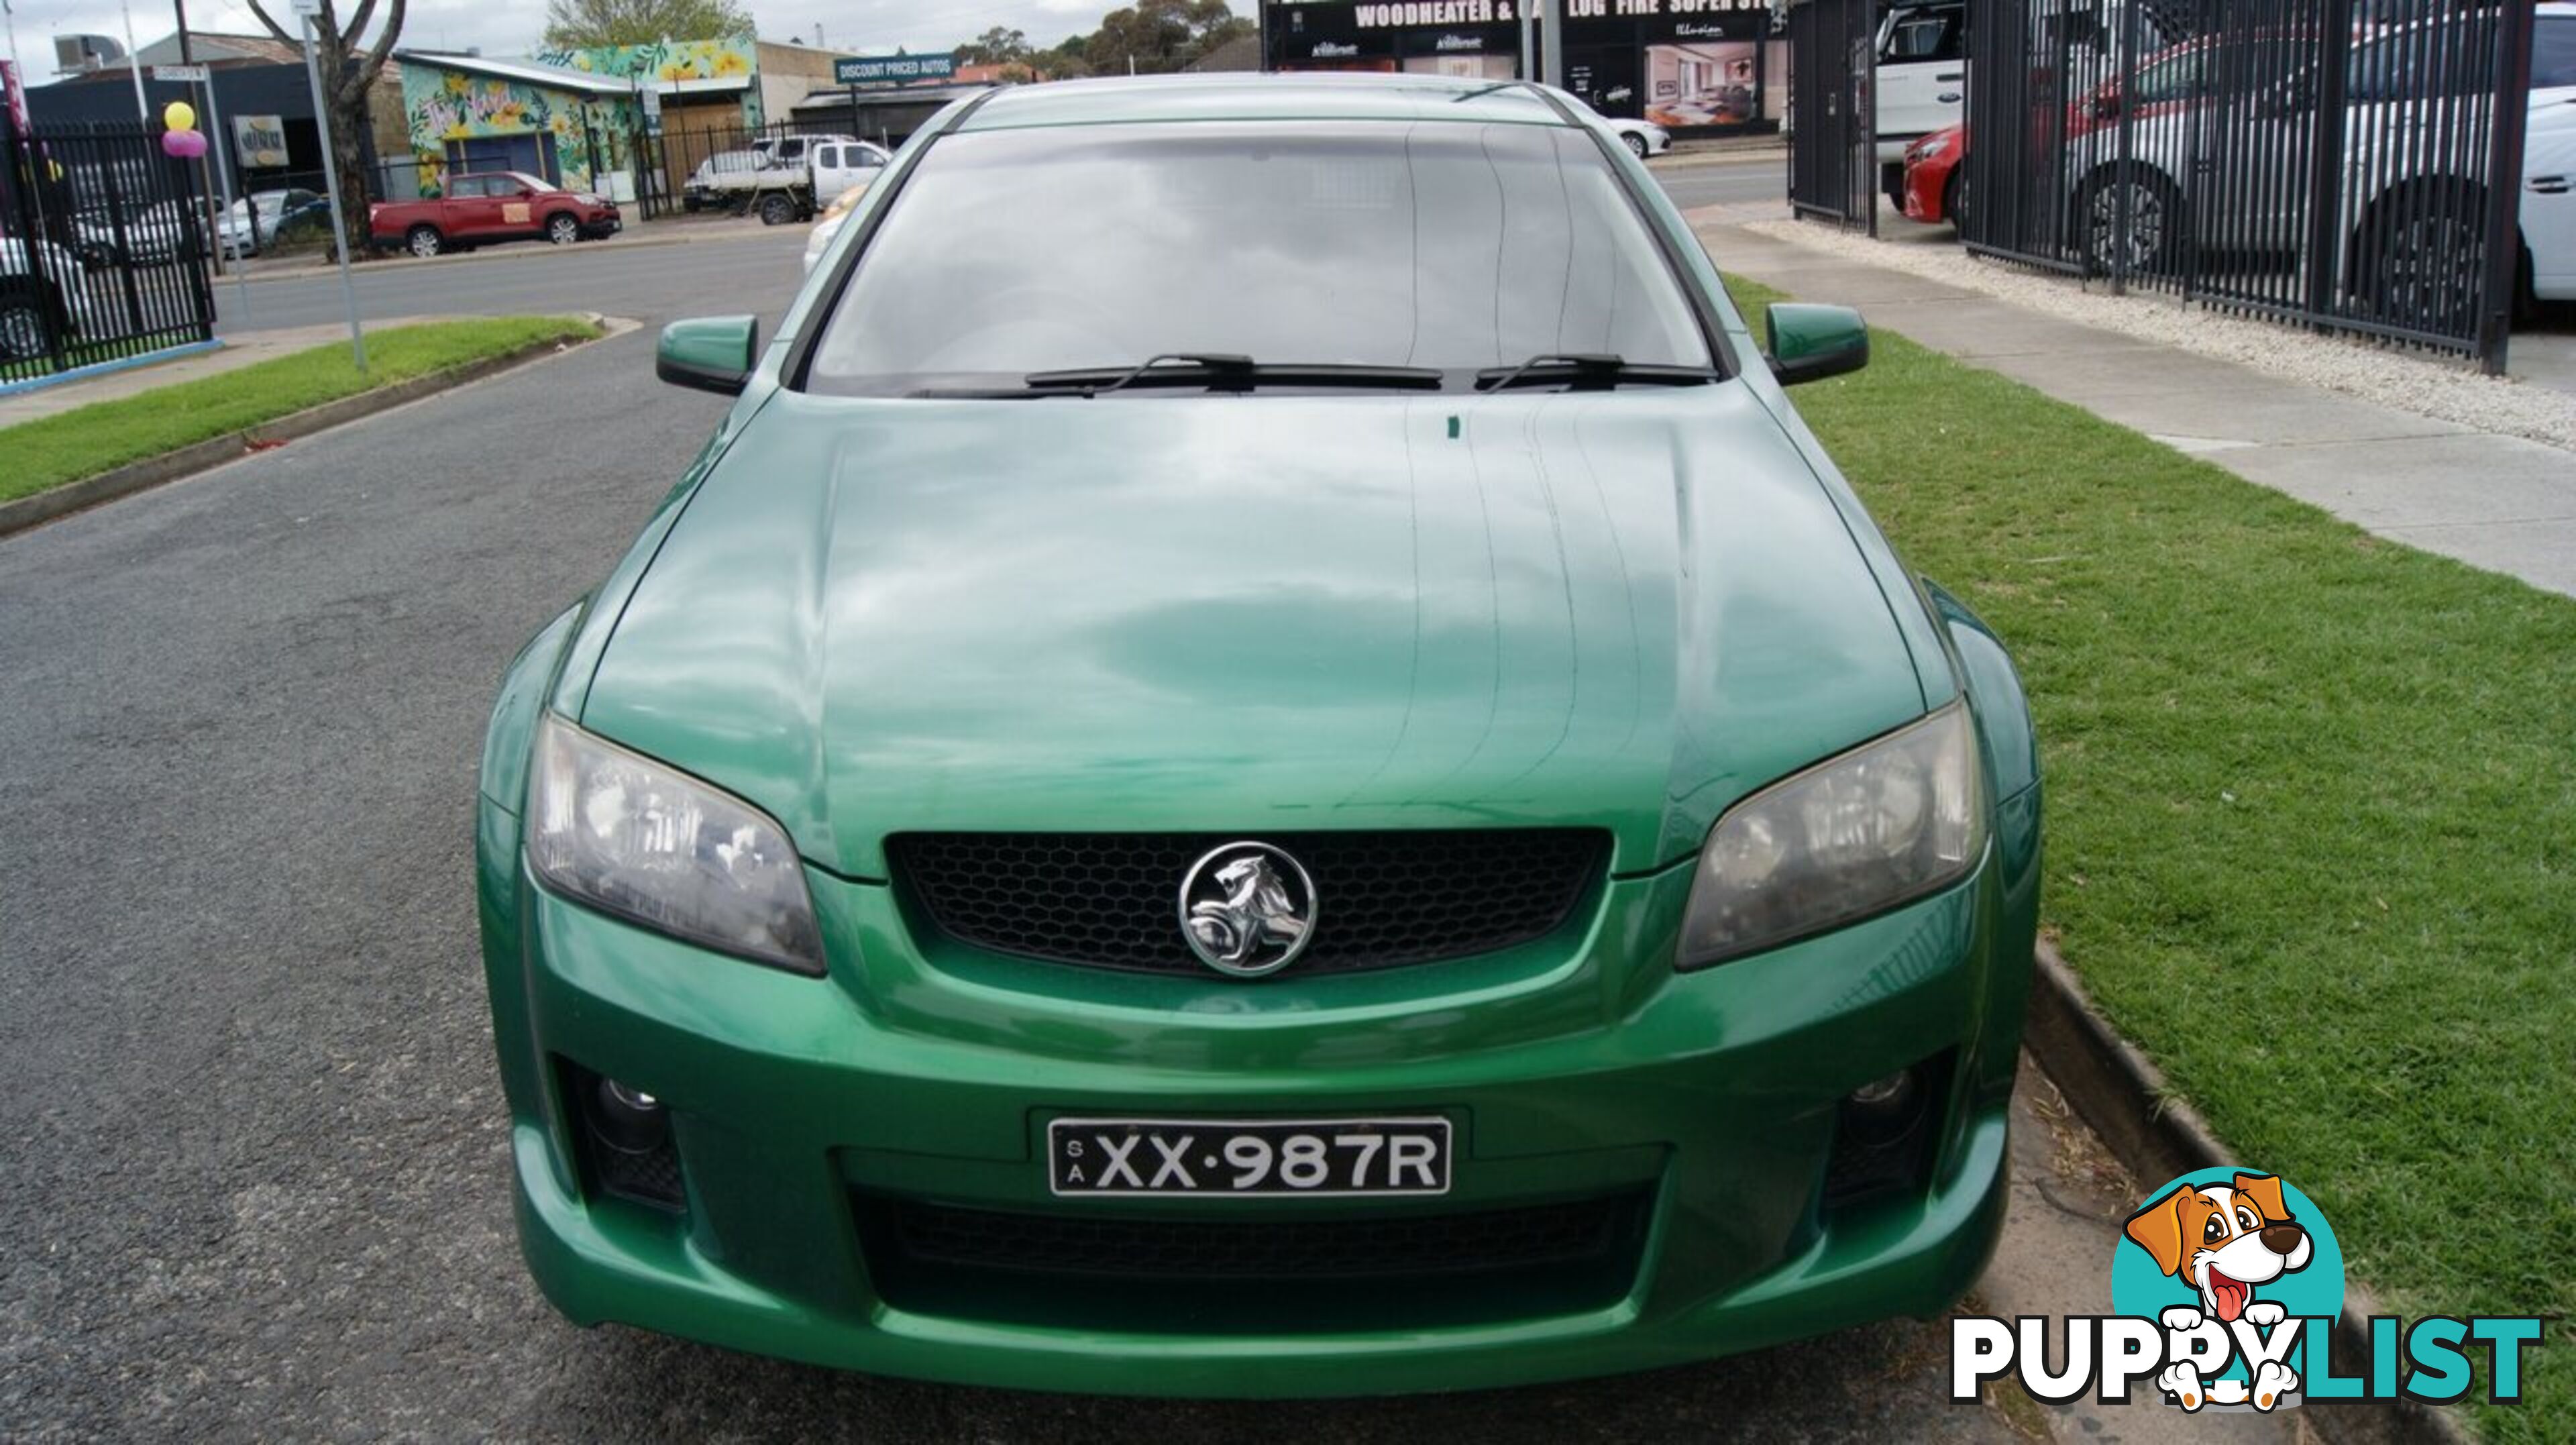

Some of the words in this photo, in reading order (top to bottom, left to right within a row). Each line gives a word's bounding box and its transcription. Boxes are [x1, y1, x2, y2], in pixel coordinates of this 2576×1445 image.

[1355, 0, 1492, 28] WOODHEATER
[1569, 0, 1607, 17] LOG
[840, 63, 884, 78] DISCOUNT
[886, 61, 919, 76] PRICED
[921, 59, 951, 74] AUTOS
